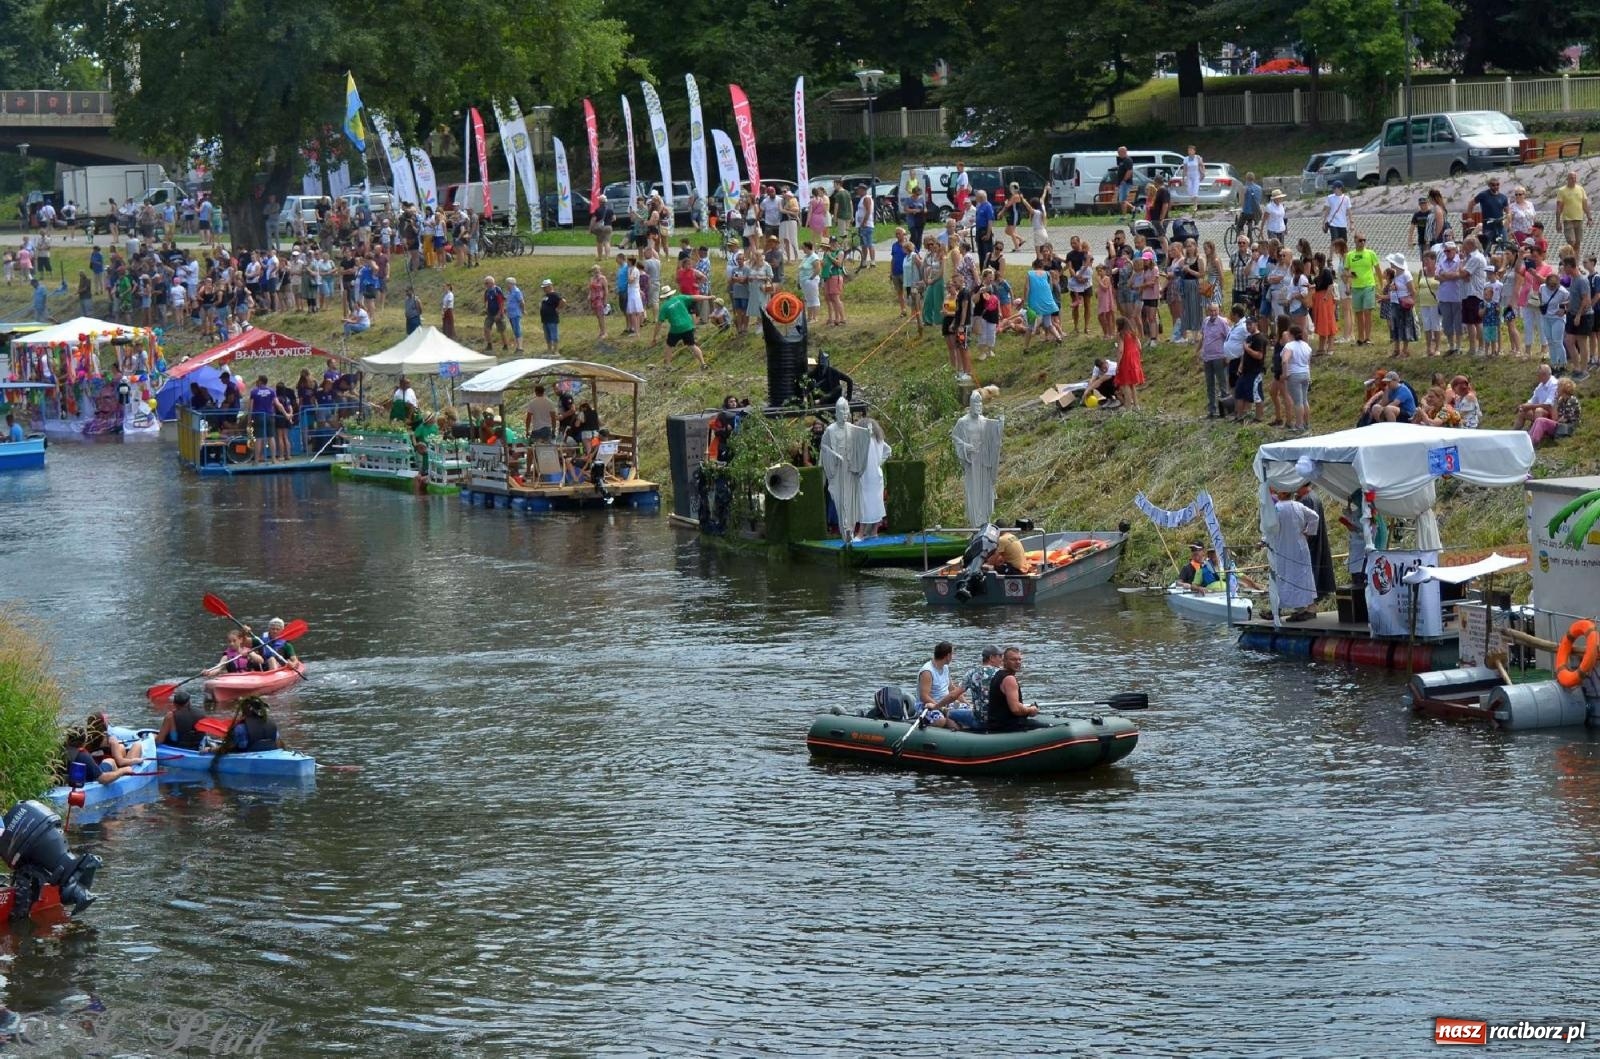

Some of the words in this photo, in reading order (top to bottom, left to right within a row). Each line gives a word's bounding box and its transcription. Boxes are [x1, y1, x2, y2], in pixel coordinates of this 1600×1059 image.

[235, 346, 313, 360] BŁAŻEJOWICE
[1445, 454, 1454, 471] 3
[9, 807, 27, 831] YAMAHA
